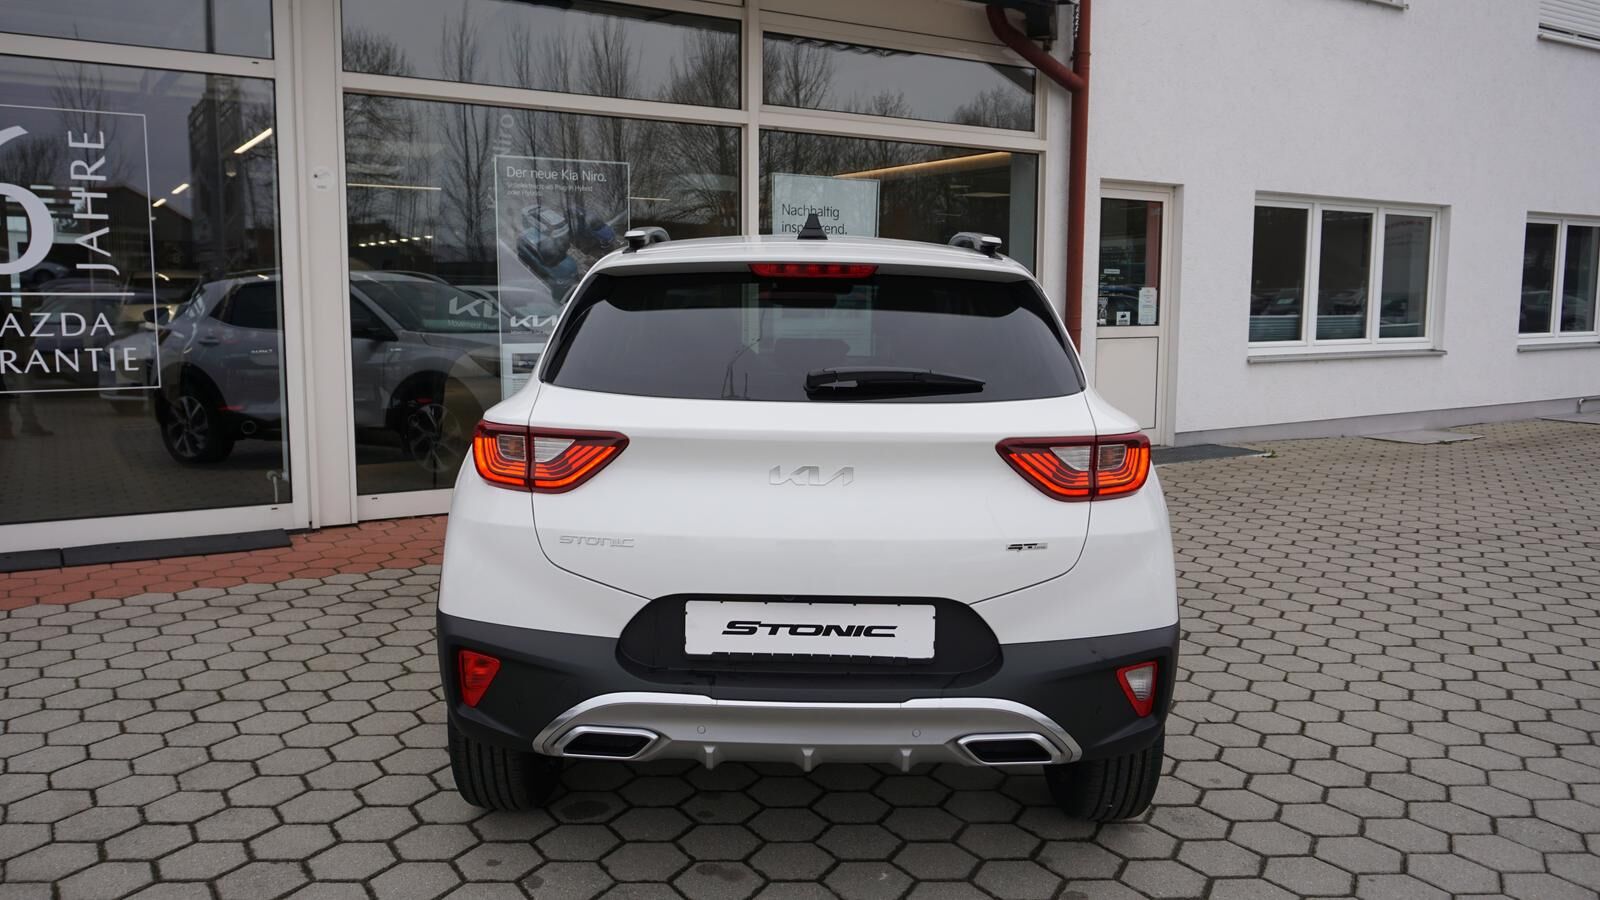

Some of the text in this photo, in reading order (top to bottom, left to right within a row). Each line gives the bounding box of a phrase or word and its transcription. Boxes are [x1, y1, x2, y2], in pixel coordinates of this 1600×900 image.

[506, 166, 607, 182] Der neue Kia Niro.
[67, 130, 120, 276] JAHRE
[781, 203, 840, 221] Nachhaltig
[781, 221, 848, 236] insprend.
[510, 315, 558, 328] KIA
[0, 347, 140, 375] RANTIE
[769, 465, 854, 487] KIA
[559, 535, 635, 548] STONIC
[722, 620, 898, 638] STONIC
